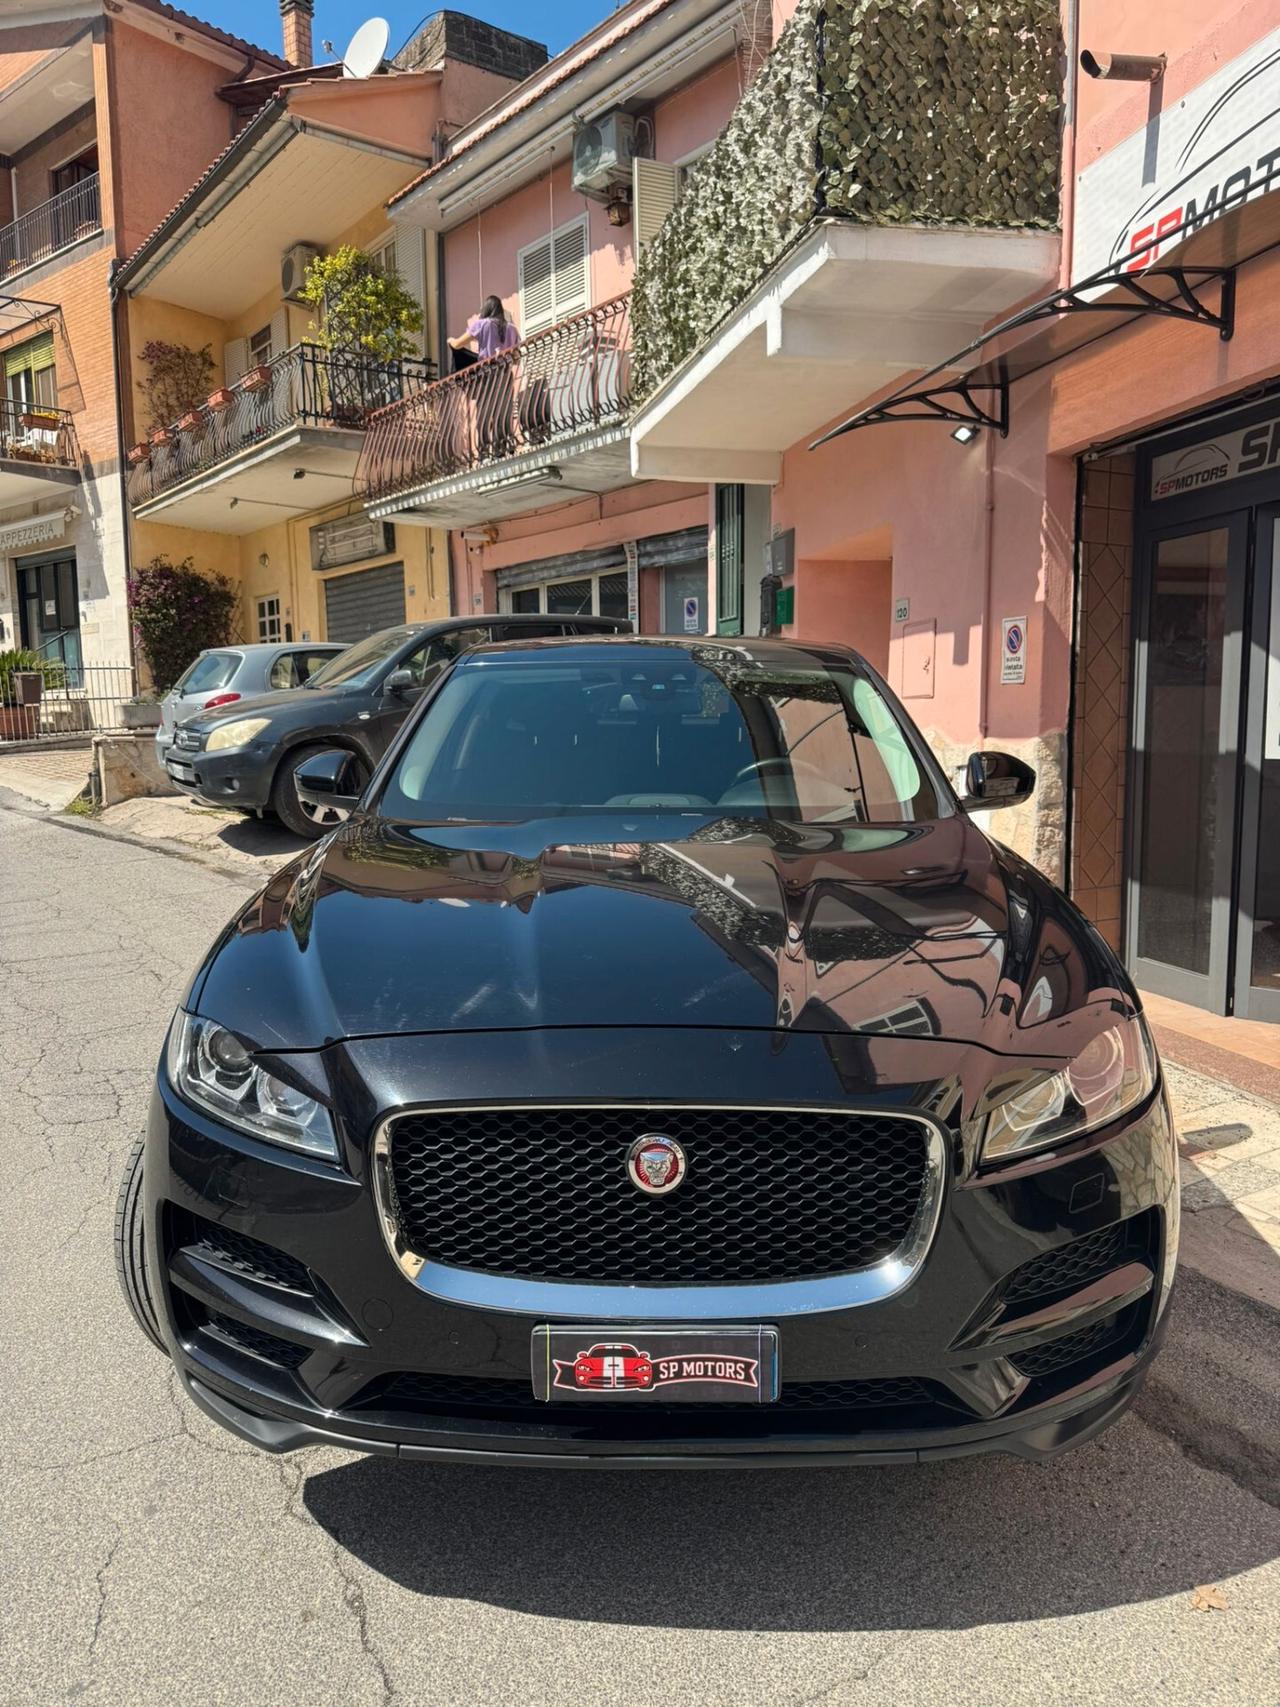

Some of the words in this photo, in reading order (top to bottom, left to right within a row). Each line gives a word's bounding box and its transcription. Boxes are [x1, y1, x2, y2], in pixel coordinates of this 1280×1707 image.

[1158, 463, 1229, 495] SPMOTORS
[0, 522, 54, 545] APPEZZERIA
[659, 1362, 679, 1380] SP
[682, 1361, 745, 1380] MOTORS
